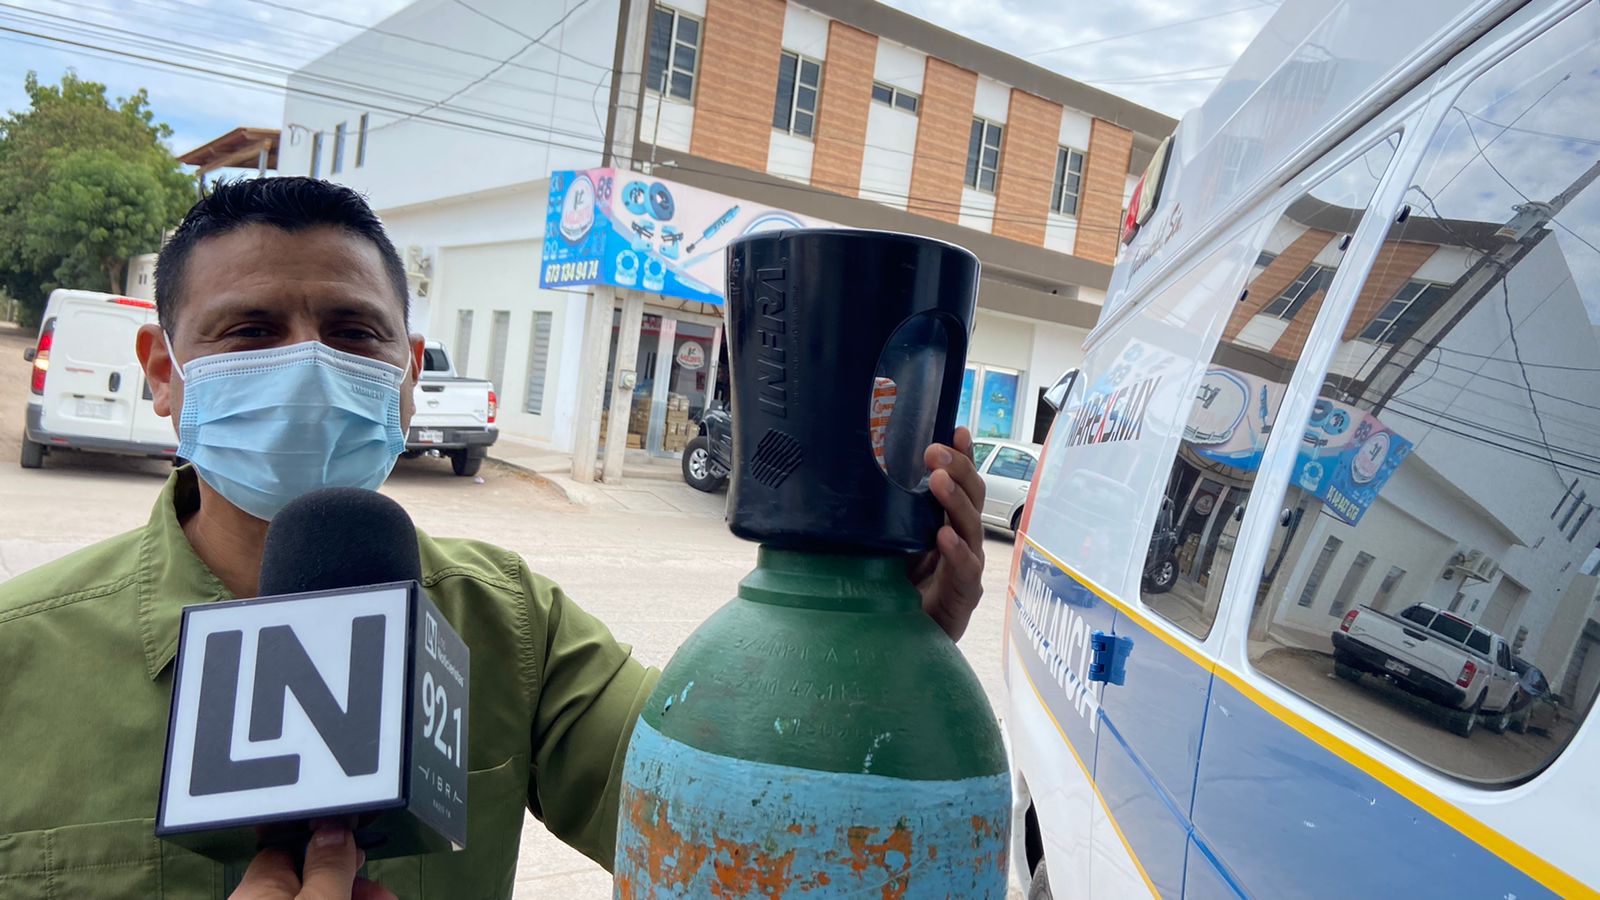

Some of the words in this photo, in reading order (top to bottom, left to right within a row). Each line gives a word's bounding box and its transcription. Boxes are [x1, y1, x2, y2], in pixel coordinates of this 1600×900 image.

[545, 264, 560, 283] 673
[756, 268, 787, 418] INFRA
[189, 614, 386, 797] LN
[422, 672, 462, 768] 92.1
[418, 765, 463, 804] VIBRA
